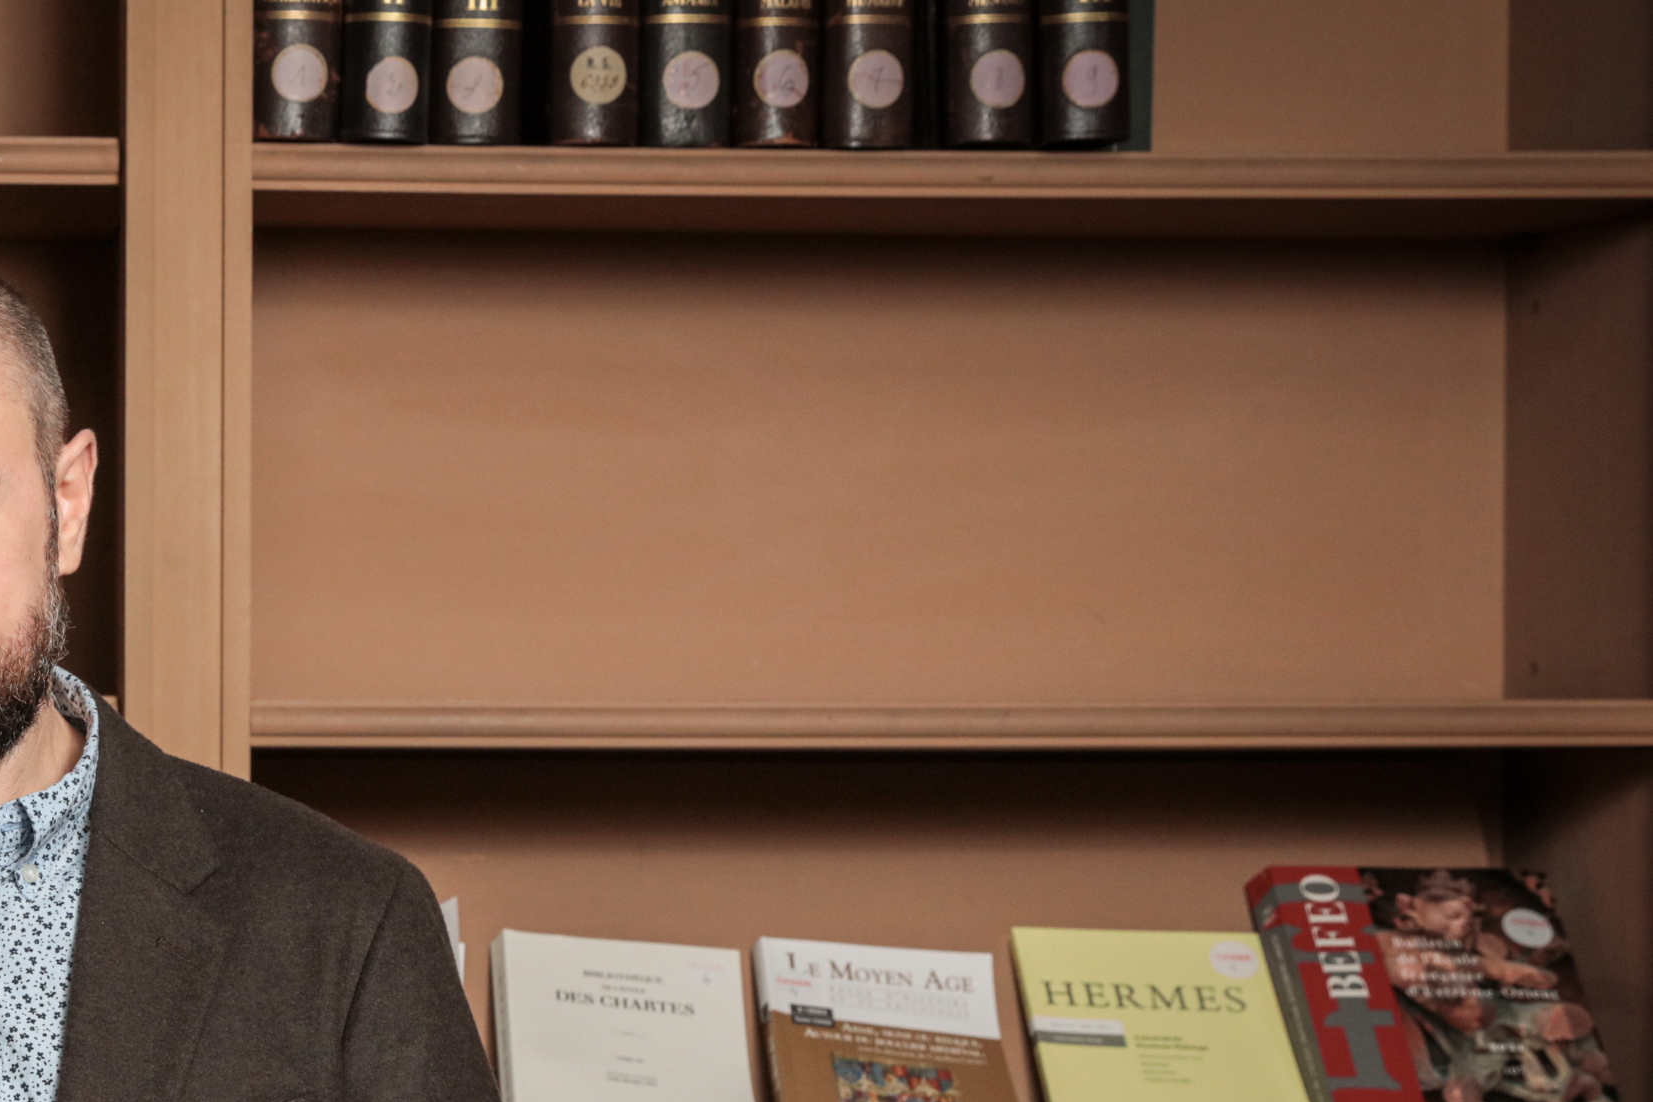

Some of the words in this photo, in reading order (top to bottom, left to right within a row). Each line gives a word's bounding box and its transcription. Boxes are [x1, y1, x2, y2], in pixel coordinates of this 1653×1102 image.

[1298, 873, 1371, 999] BEFEO
[828, 960, 915, 988] MOYEN
[924, 970, 975, 994] AGE
[555, 989, 595, 1005] DES
[599, 995, 696, 1017] CHARTES
[1040, 979, 1248, 1014] HERMES
